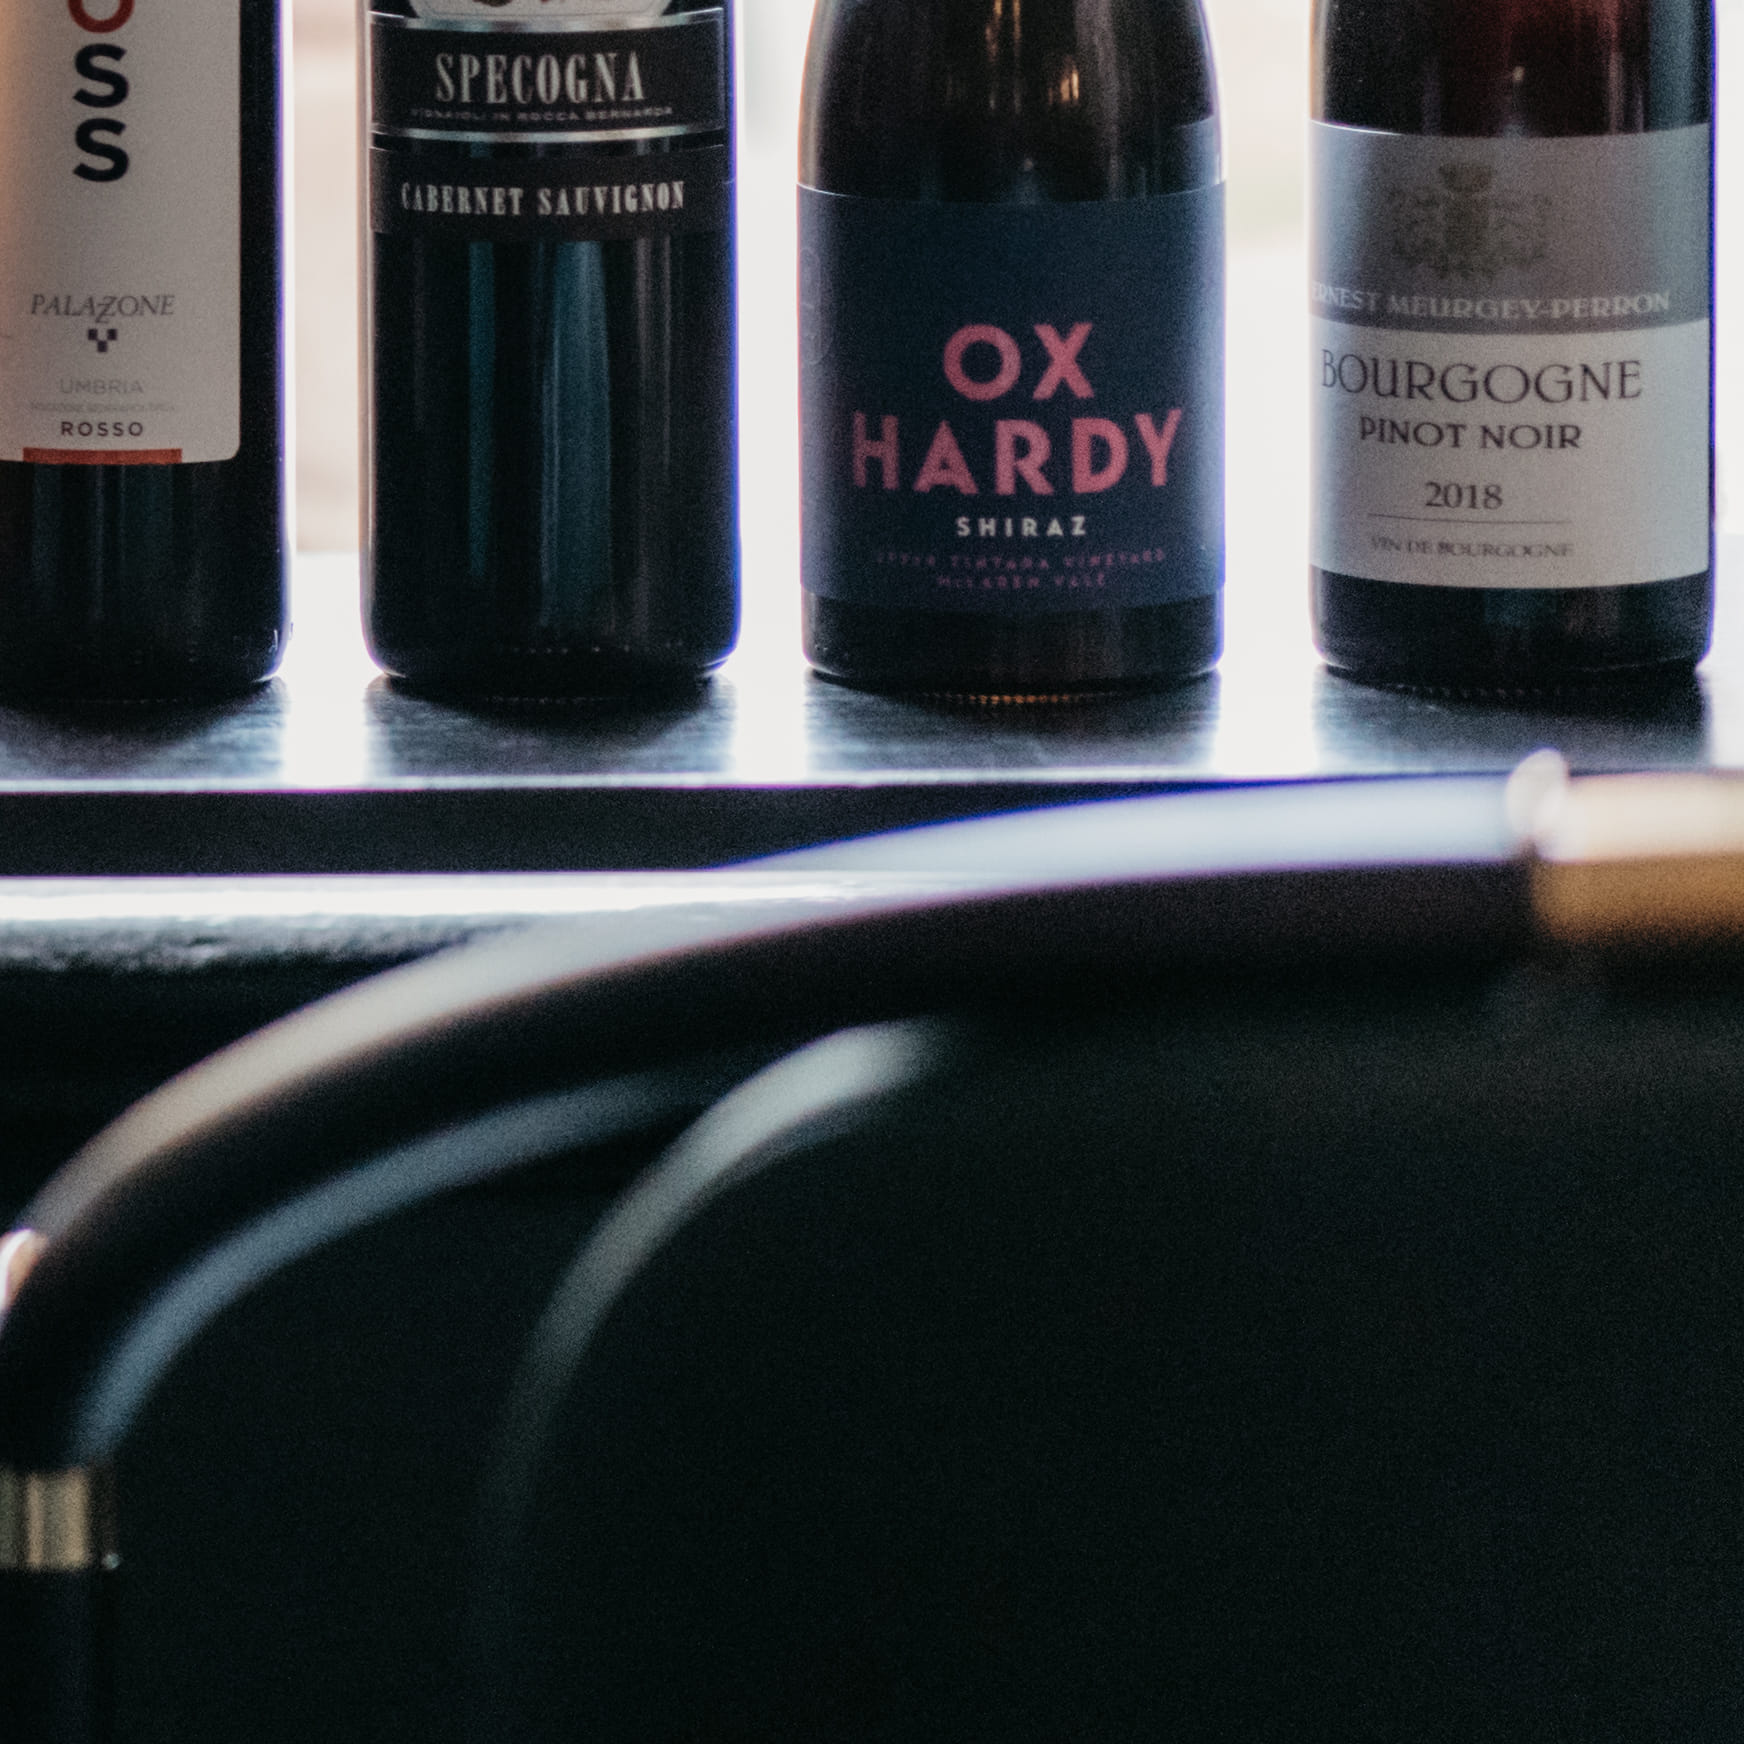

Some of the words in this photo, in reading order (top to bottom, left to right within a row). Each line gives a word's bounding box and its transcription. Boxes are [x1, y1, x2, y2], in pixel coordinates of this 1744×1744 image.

[435, 51, 645, 105] SPECOGNA
[401, 182, 524, 216] CABERNET
[537, 180, 685, 216] SAUVIGNON
[1388, 290, 1670, 319] MEURGEY-PERRON
[943, 322, 1095, 401] OX
[1322, 348, 1642, 404] BOURGOGNE
[60, 378, 145, 395] UMBRIA
[60, 421, 145, 438] ROSSO
[1360, 415, 1467, 449] PINOT
[1480, 423, 1583, 451] NOIR
[852, 408, 1183, 496] HARDY
[1425, 481, 1504, 510] 2018
[956, 516, 1087, 537] SHIRAZ
[1437, 540, 1574, 558] BOURGOGNE
